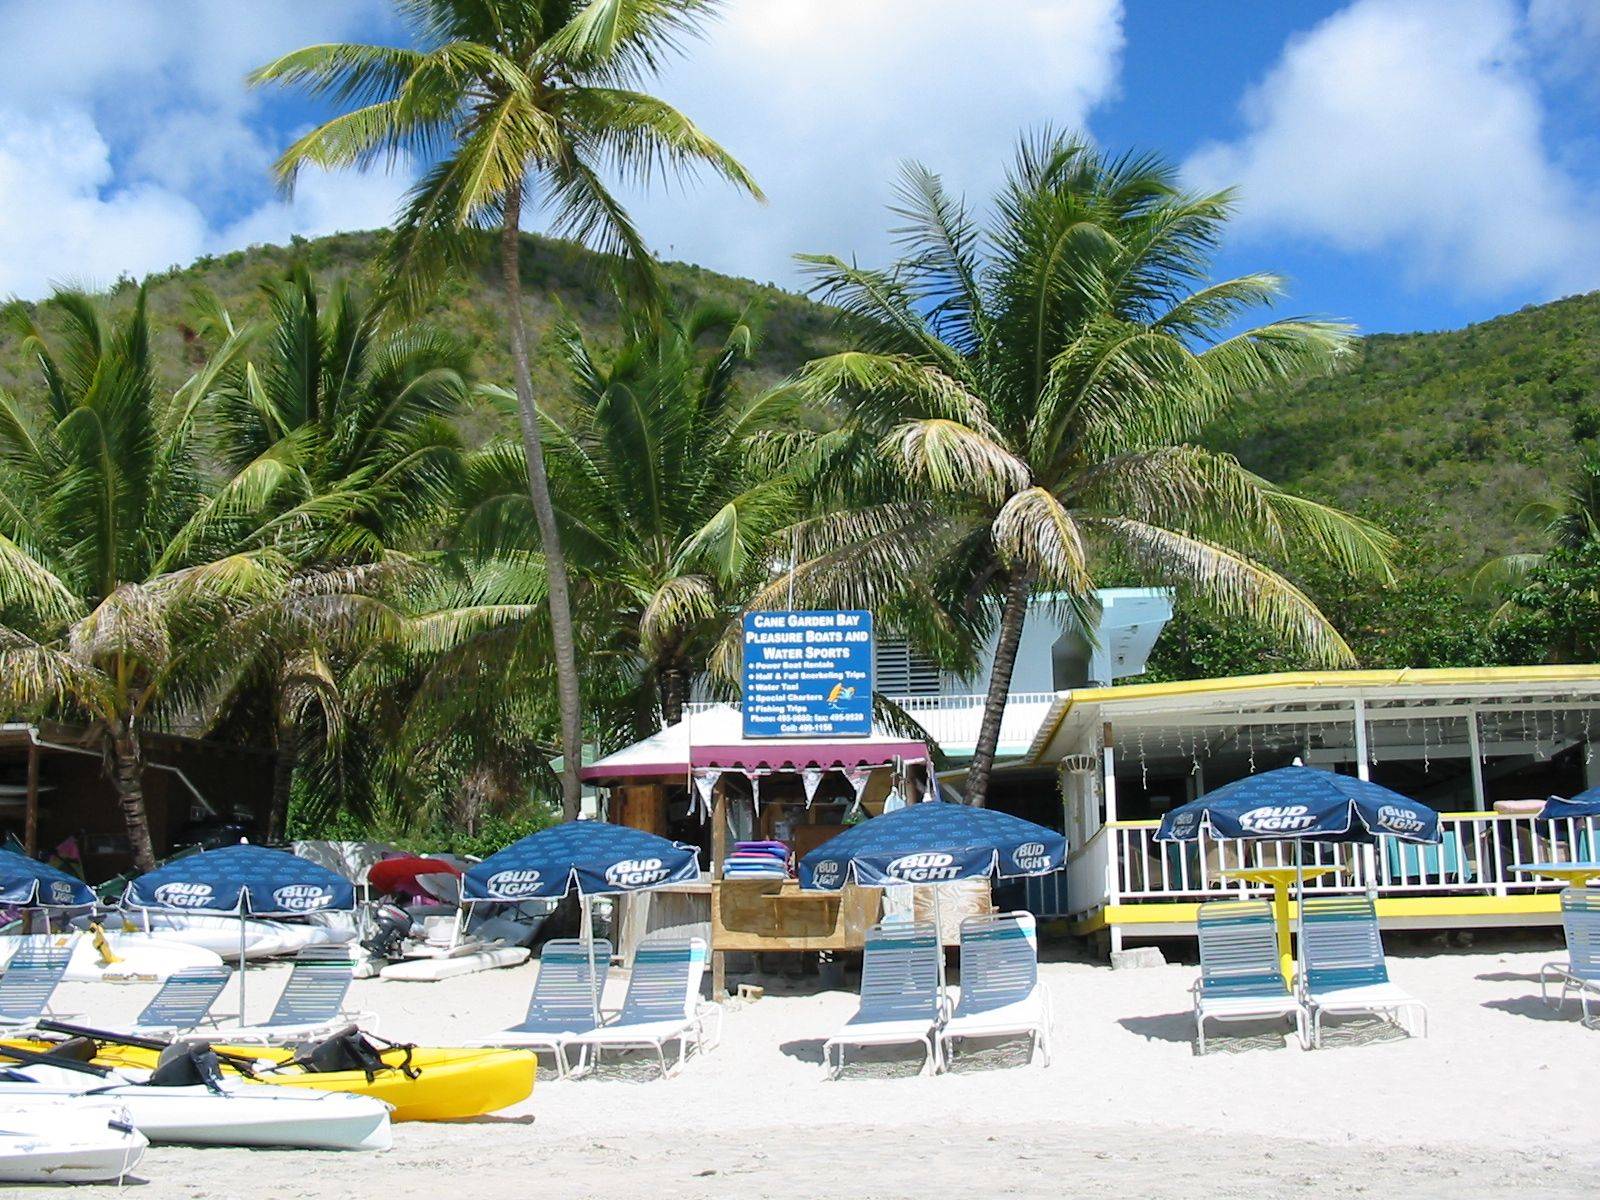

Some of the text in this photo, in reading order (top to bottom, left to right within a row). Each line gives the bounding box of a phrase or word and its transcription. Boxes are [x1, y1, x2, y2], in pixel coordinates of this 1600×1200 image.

[754, 613, 860, 628] CANE GARDEN BAY
[745, 630, 869, 644] PLEASURE BOATS AND
[763, 646, 850, 660] WATER SPORTS
[755, 683, 780, 691] Water
[755, 692, 823, 703] Special Charters
[755, 704, 786, 714] Fishing
[1250, 805, 1308, 818] BUD
[1386, 807, 1417, 821] BUD
[1240, 816, 1317, 831] LIGHT
[1378, 816, 1426, 832] LIGHT
[1018, 844, 1046, 857] BUD
[614, 859, 662, 873] BUD
[900, 853, 954, 869] BUD
[497, 870, 540, 883] BUD
[608, 869, 671, 886] LIGHT
[165, 883, 213, 896] BUD
[281, 886, 323, 898] BUD
[488, 881, 545, 895] LIGHT
[157, 893, 216, 907] LIGHT
